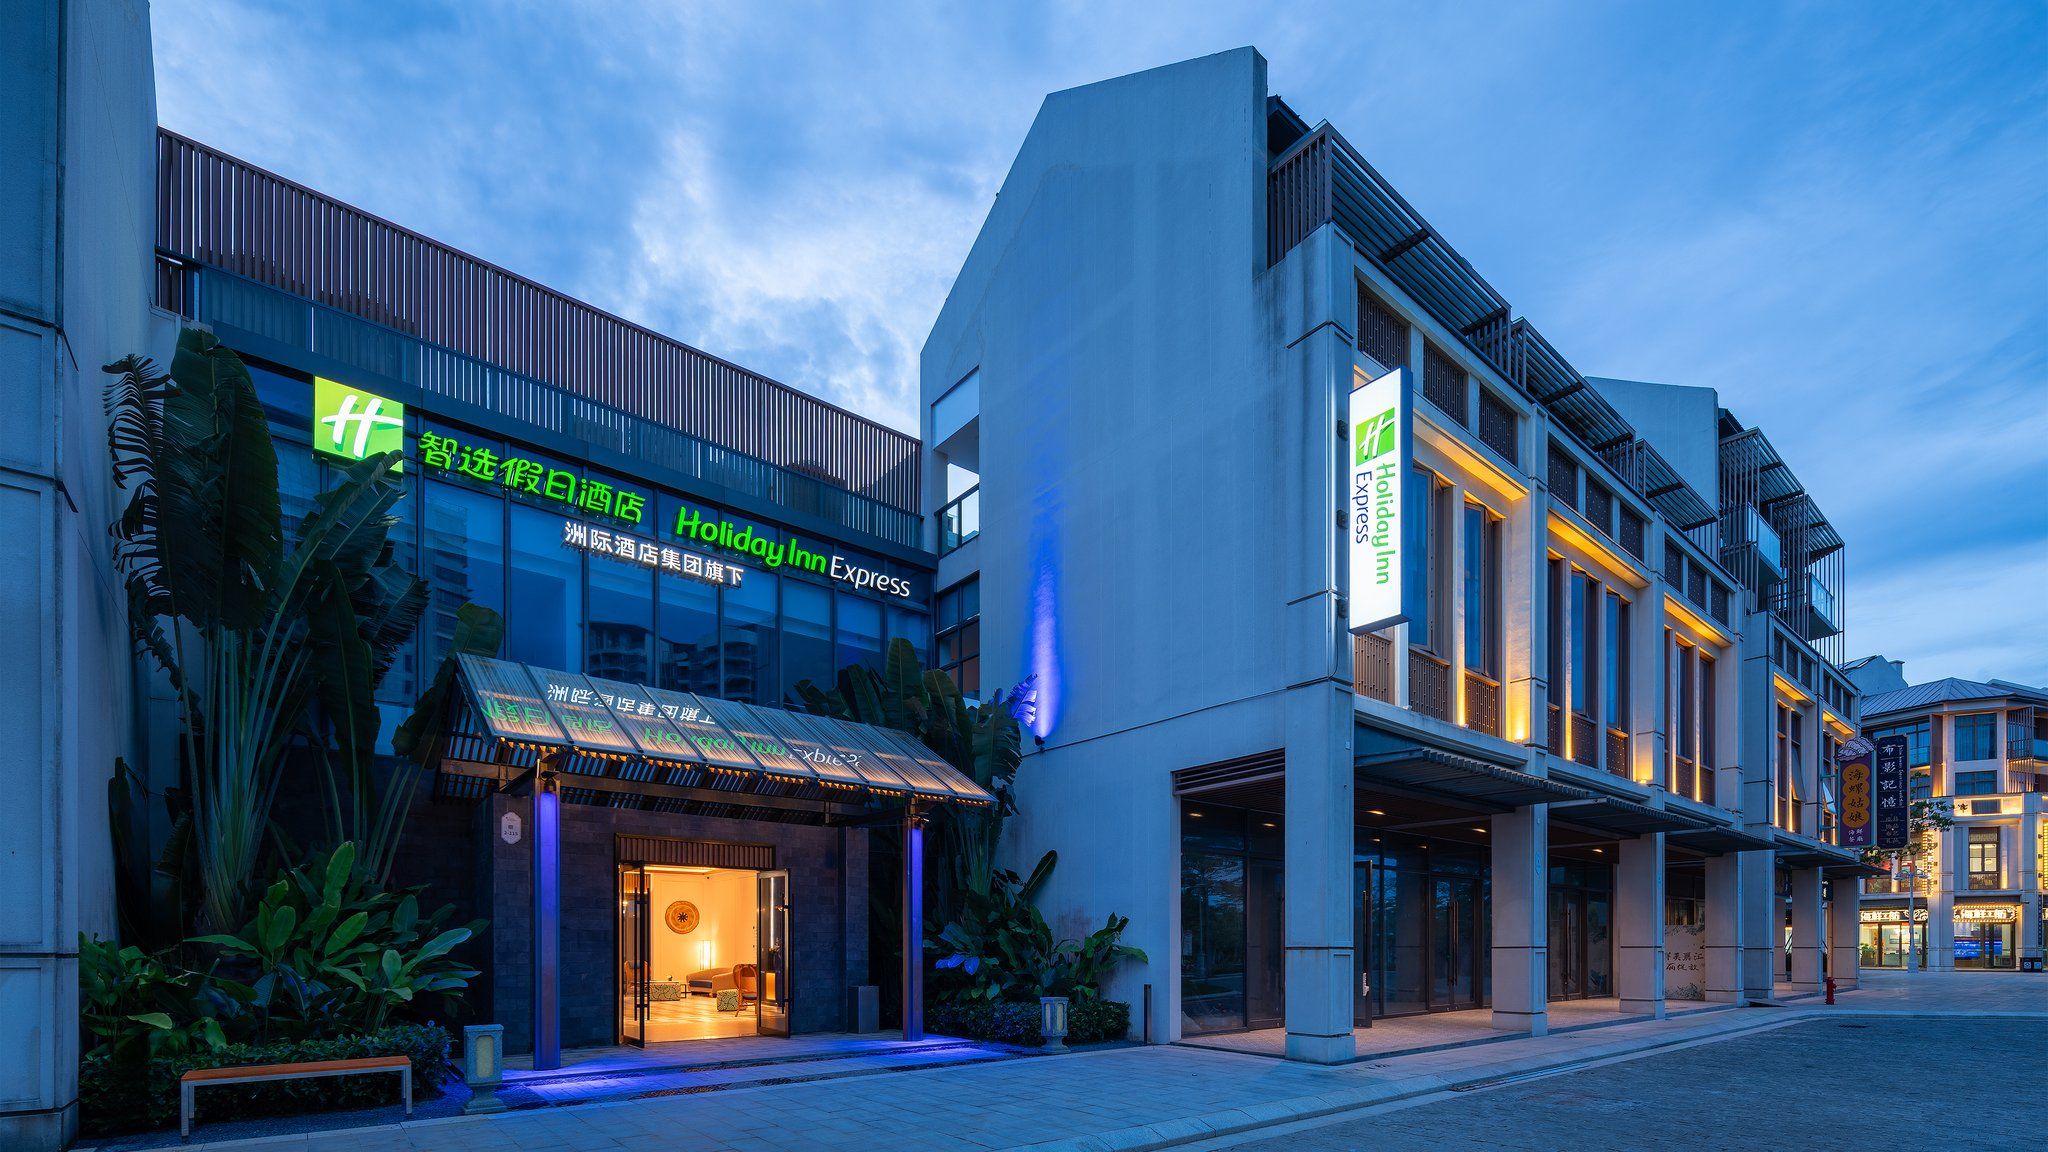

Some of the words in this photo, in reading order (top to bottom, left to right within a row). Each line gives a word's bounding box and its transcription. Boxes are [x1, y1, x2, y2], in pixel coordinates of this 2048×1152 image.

[418, 430, 645, 523] 智选假日酒店
[1352, 471, 1372, 544] Express
[1371, 463, 1396, 547] Holiday
[564, 521, 745, 586] 洲际酒店集团旗下
[676, 506, 785, 574] Holiday
[787, 537, 827, 573] Inn
[830, 555, 910, 597] Express
[1376, 549, 1396, 585] Inn
[1848, 768, 1864, 823] 海螺姑娘
